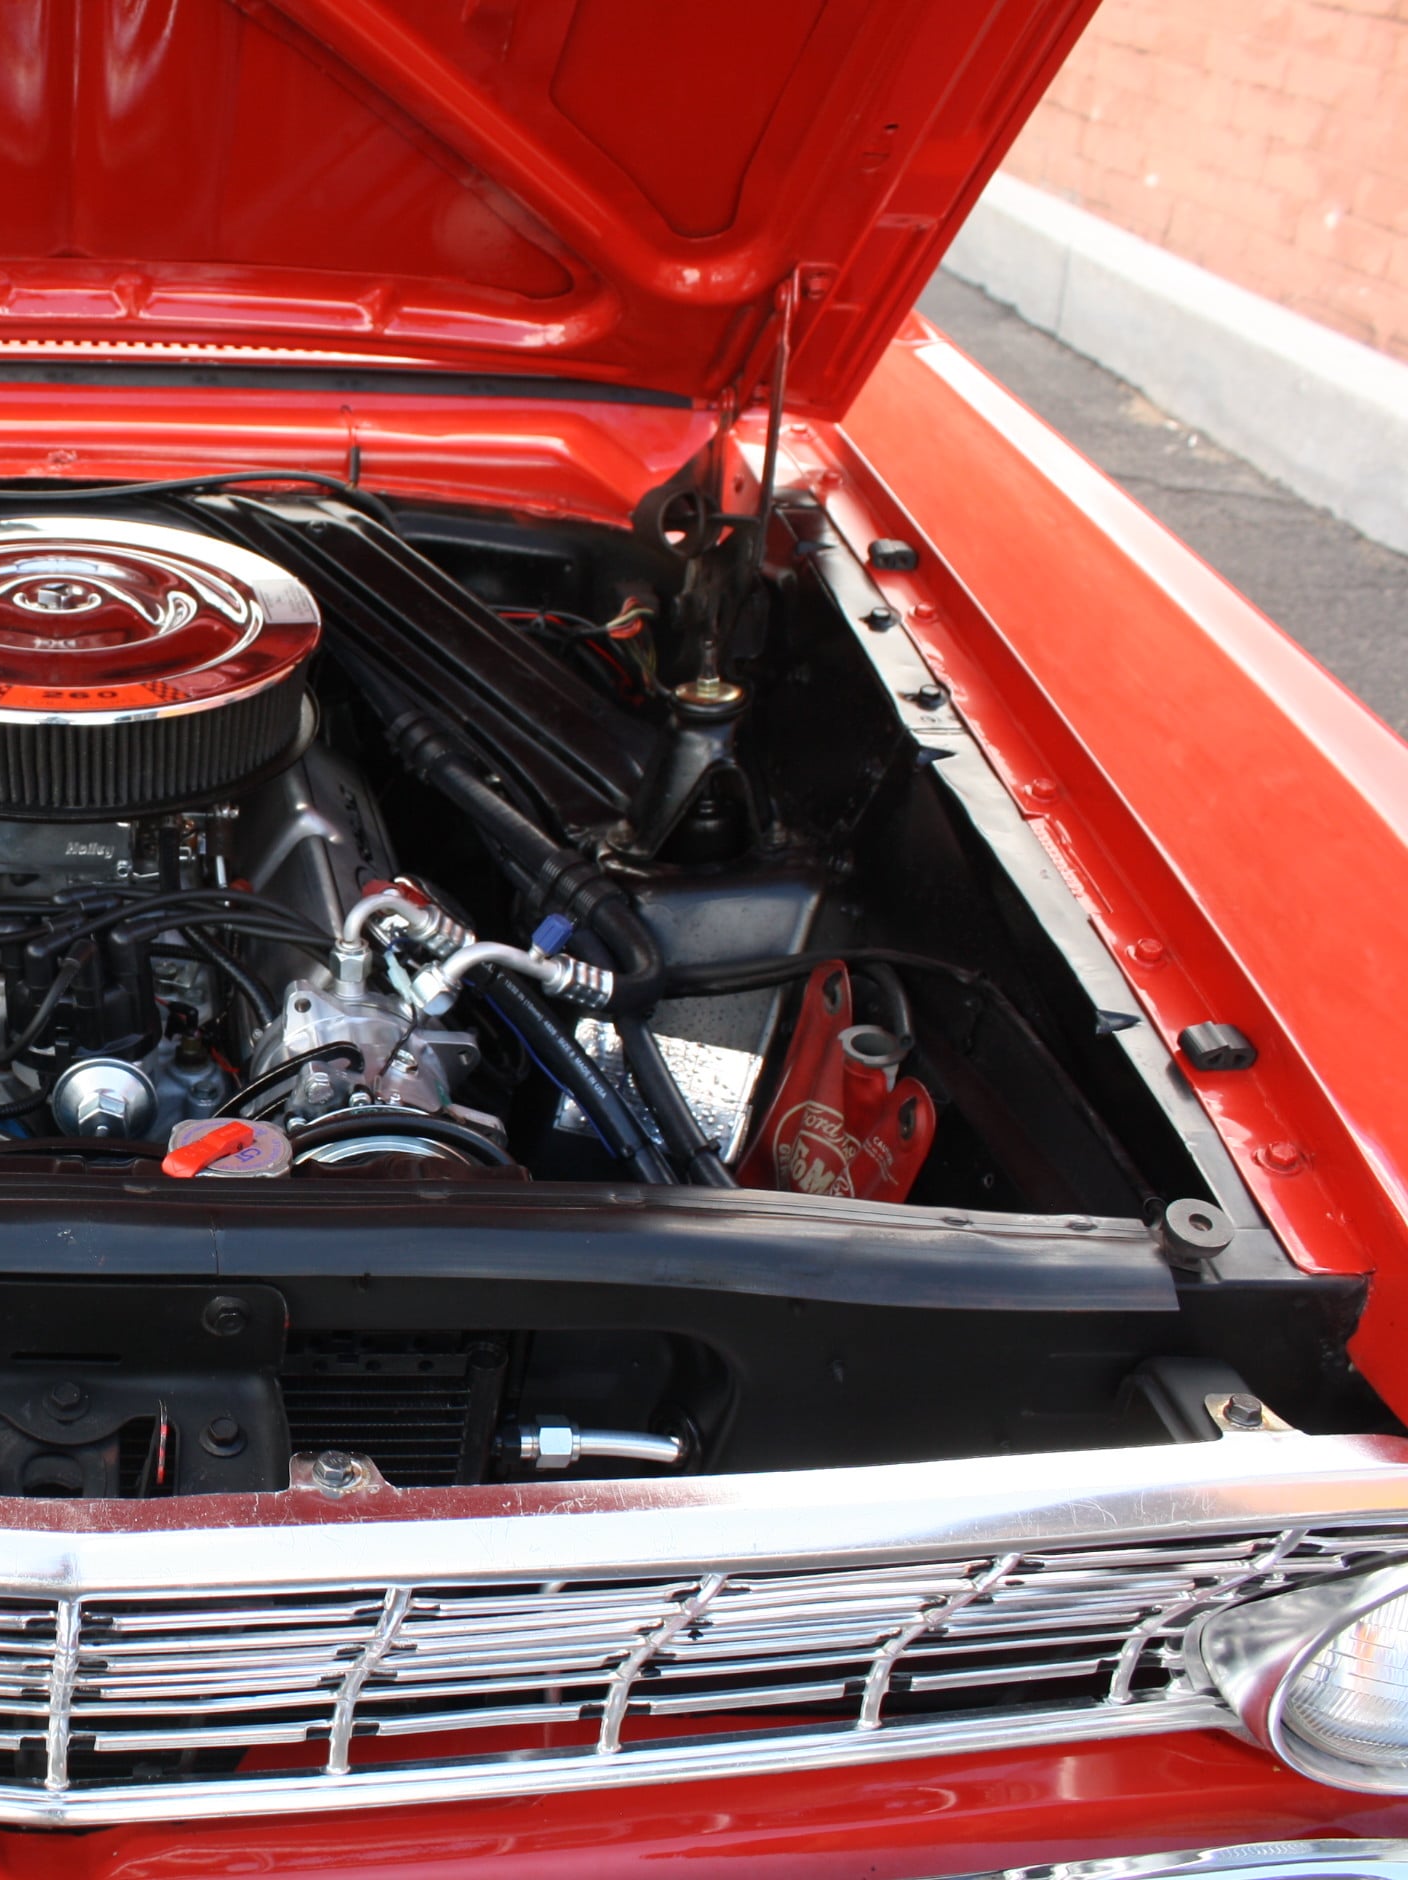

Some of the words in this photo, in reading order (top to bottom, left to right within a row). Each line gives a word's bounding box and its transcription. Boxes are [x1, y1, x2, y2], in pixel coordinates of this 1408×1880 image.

[41, 690, 119, 700] 260
[65, 841, 115, 859] Holley
[574, 1056, 591, 1078] MADE
[594, 1082, 607, 1099] USA
